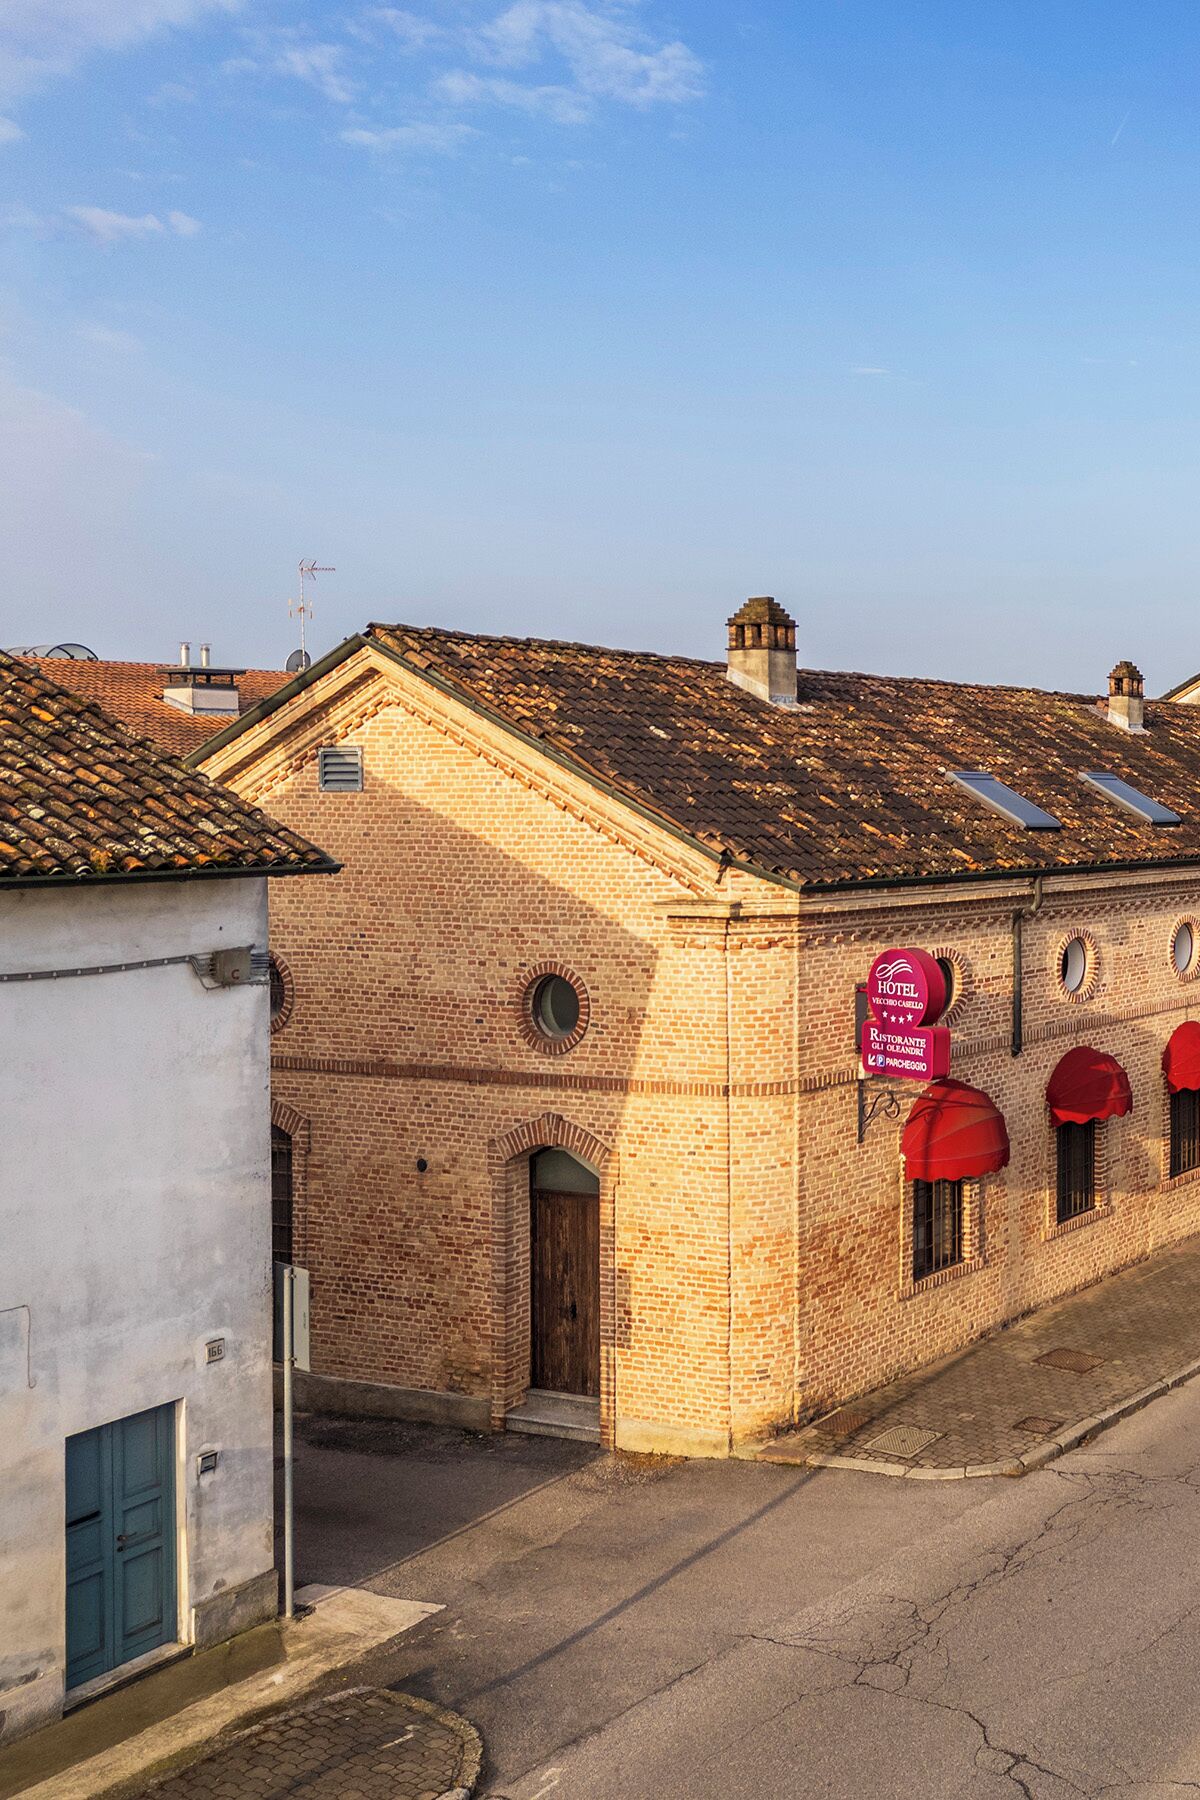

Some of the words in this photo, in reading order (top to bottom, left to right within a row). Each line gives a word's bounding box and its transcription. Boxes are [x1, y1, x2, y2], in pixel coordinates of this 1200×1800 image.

[878, 981, 919, 997] HOTEL
[872, 997, 898, 1006] VECCHIO
[897, 1000, 924, 1010] CASELLO
[871, 1042, 884, 1050] GLI
[886, 1044, 924, 1056] OLEANDRI
[886, 1058, 927, 1071] PARCHEGGIO
[208, 1345, 222, 1358] 166
